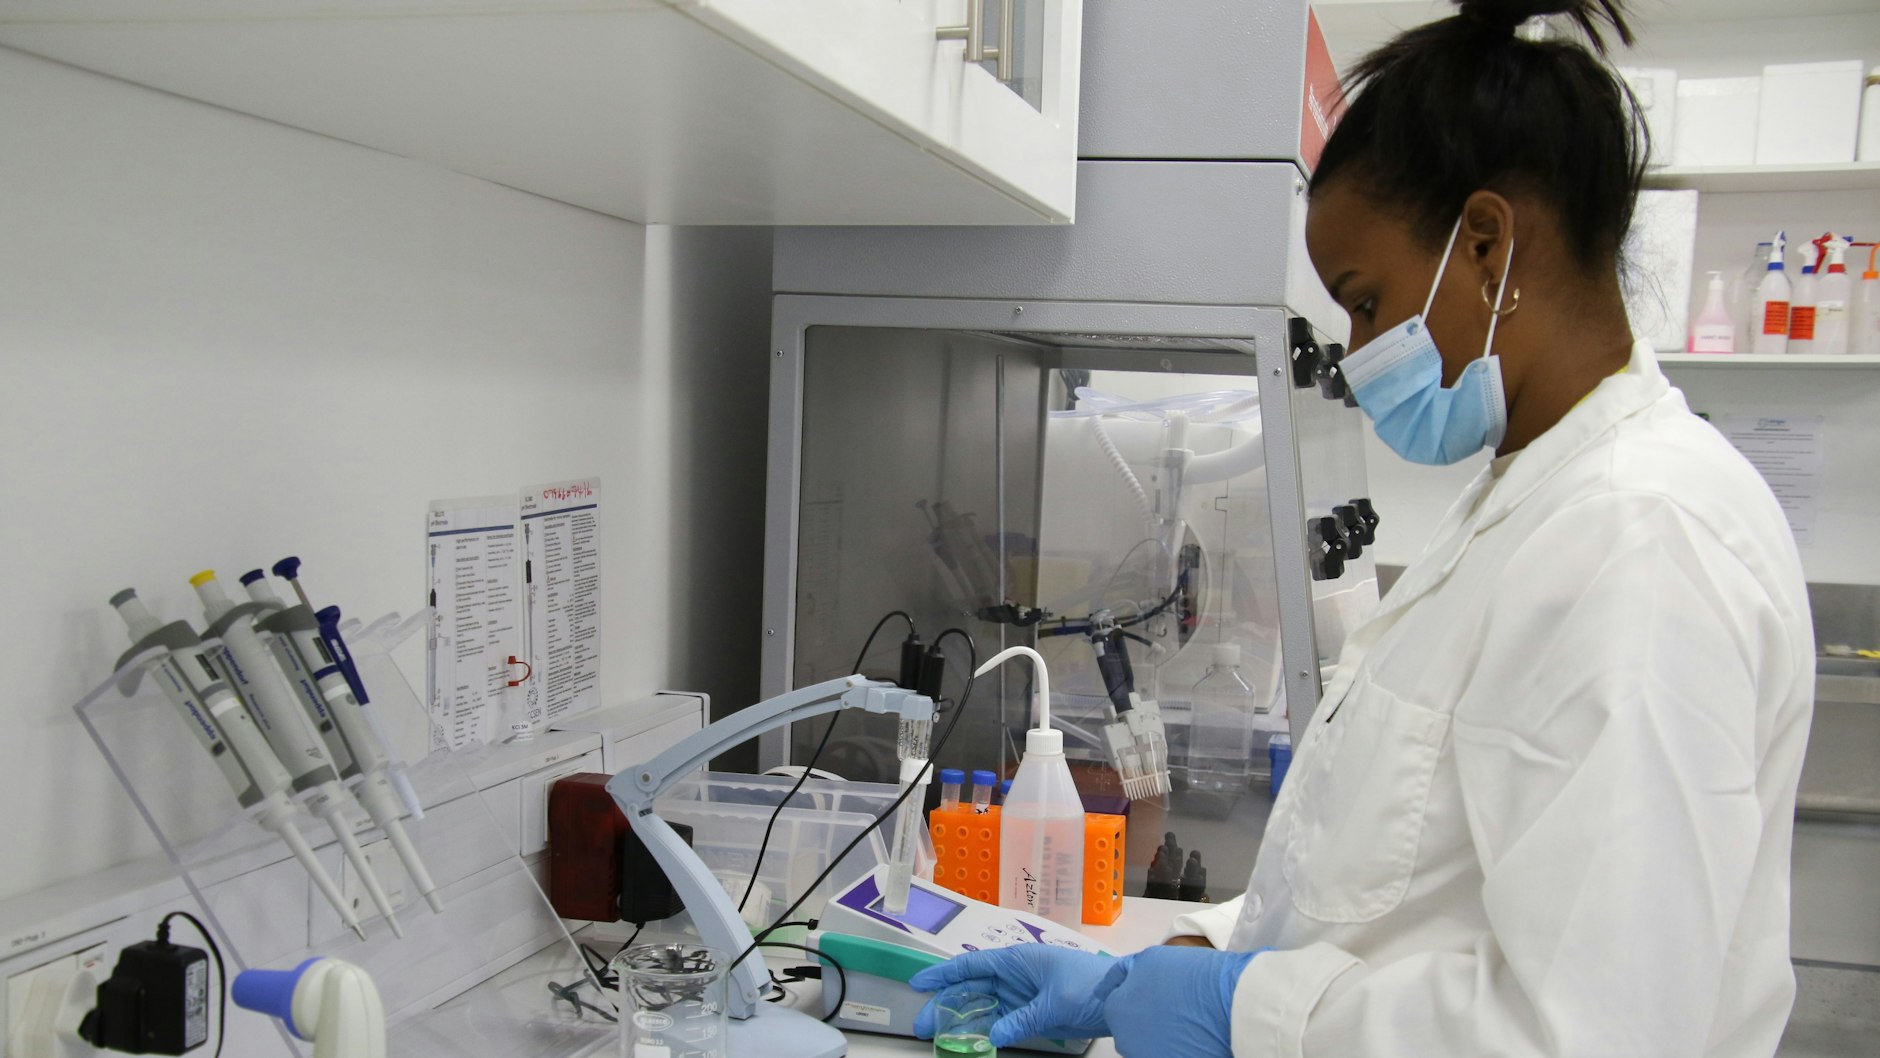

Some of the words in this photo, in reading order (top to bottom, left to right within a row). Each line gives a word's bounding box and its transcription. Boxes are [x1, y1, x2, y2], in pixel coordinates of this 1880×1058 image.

[300, 679, 326, 718] eppendorf
[184, 700, 216, 740] eppendorf
[1022, 867, 1037, 909] Azlon
[701, 1001, 718, 1015] 200
[702, 1025, 718, 1039] 150
